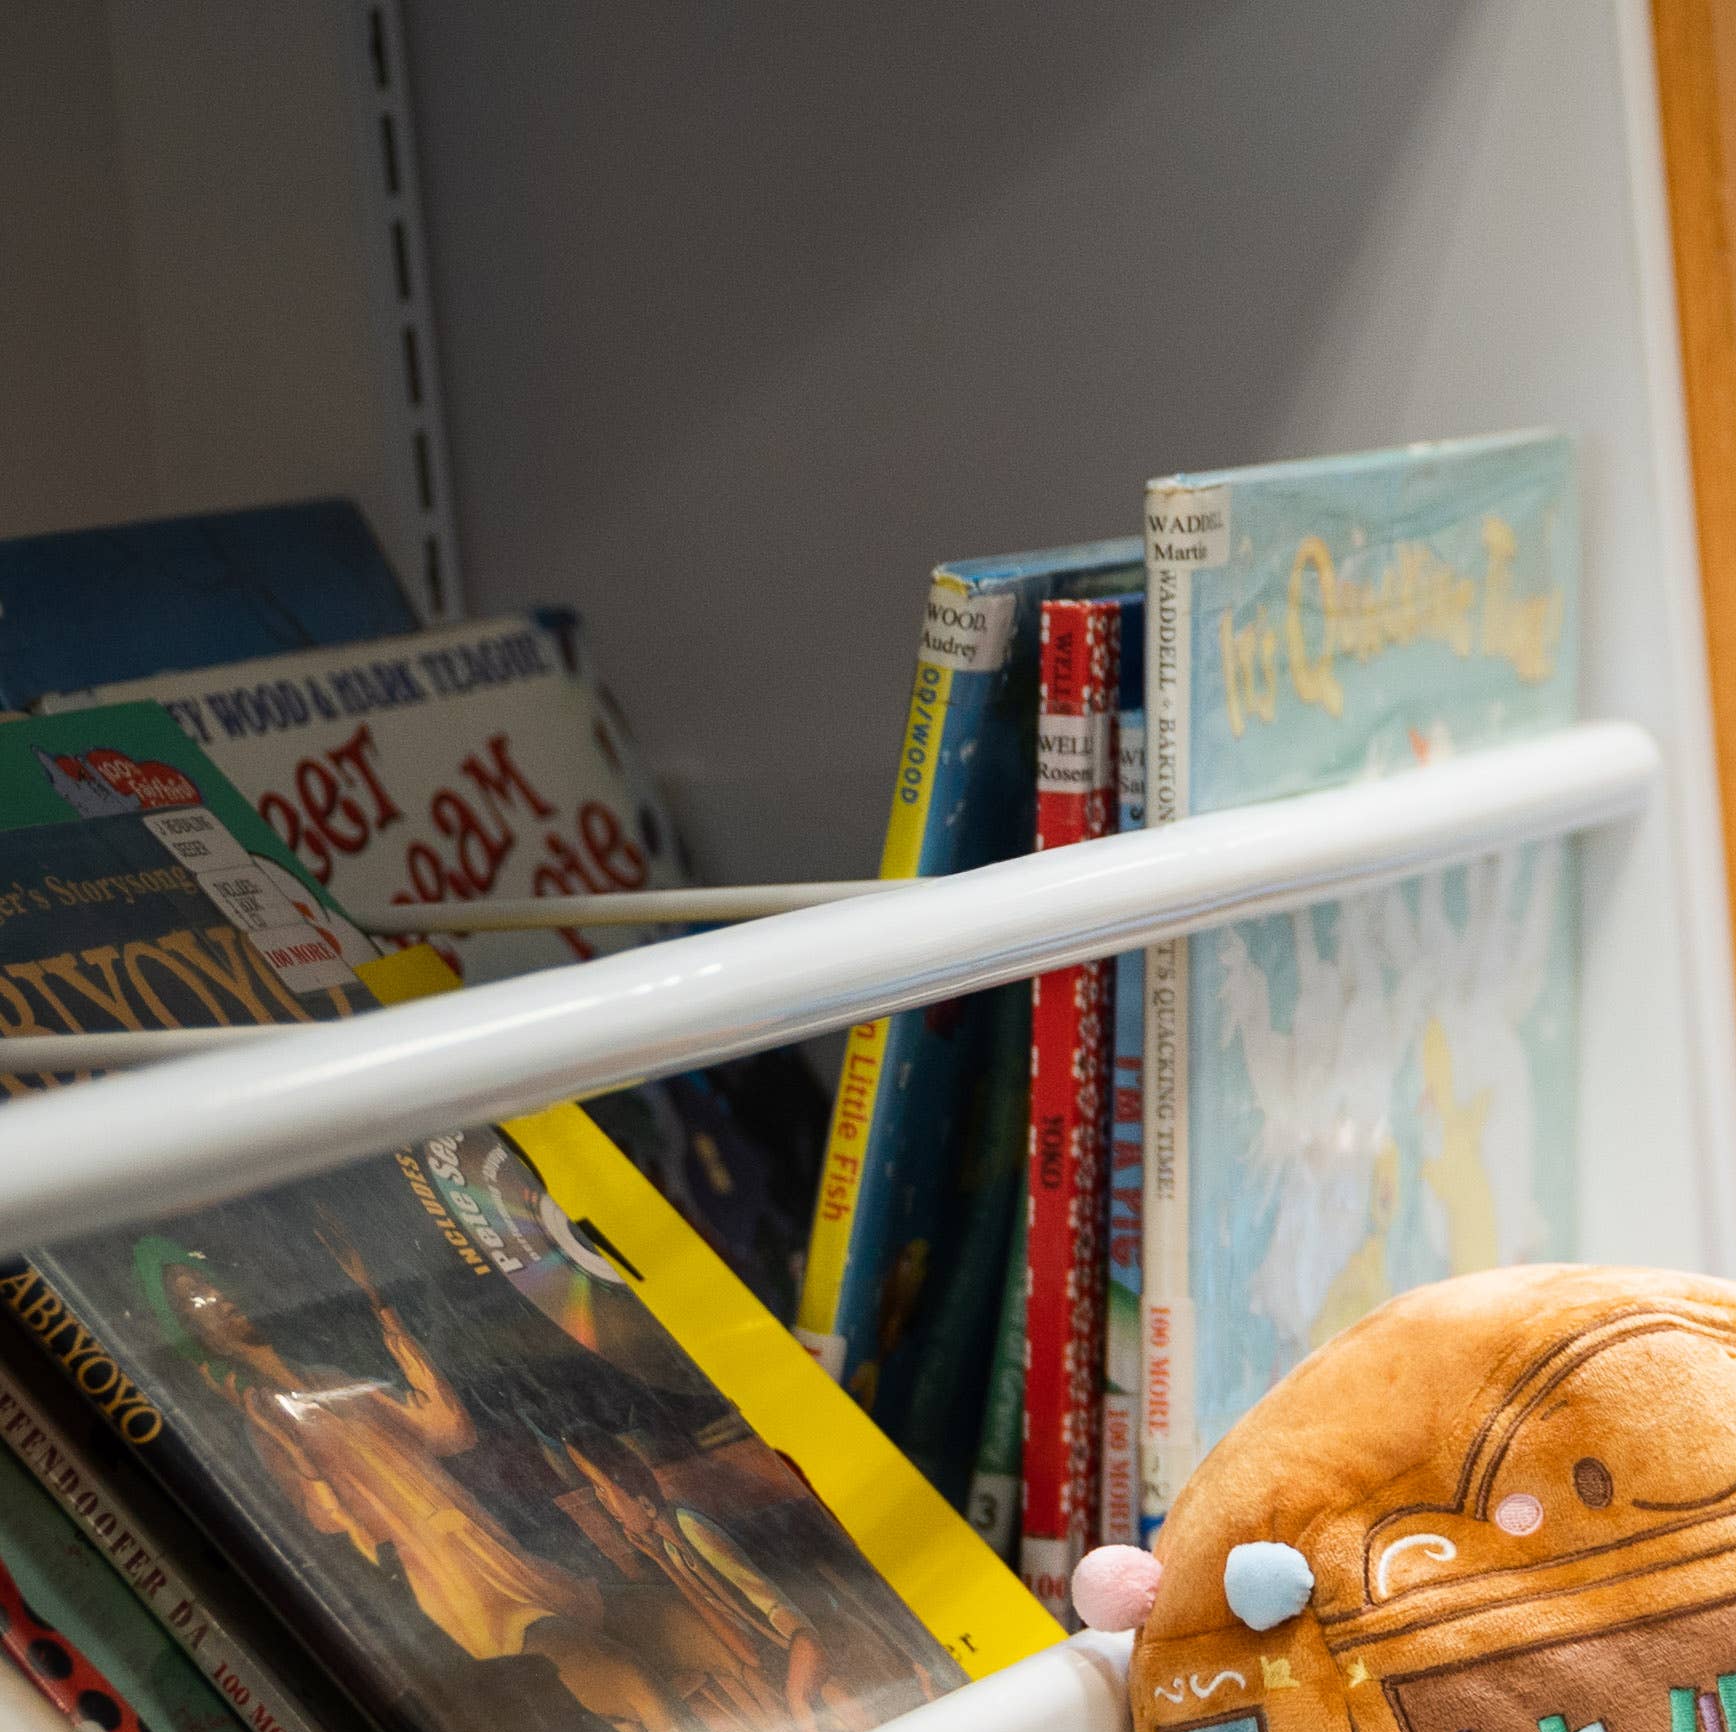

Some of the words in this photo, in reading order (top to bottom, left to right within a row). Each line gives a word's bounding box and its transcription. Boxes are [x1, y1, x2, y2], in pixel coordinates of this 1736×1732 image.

[1159, 570, 1177, 690] WADDELL
[1158, 719, 1176, 822] BARTON
[1153, 988, 1176, 1120] QUACKING
[837, 1054, 877, 1140] Little
[823, 1153, 859, 1221] Fish
[1040, 1115, 1065, 1190] YOKO
[396, 1150, 492, 1276] INCLUDES
[450, 1190, 524, 1274] Pete
[0, 1266, 163, 1445] ABIYOYO
[1149, 1307, 1171, 1348] 100
[1107, 1410, 1130, 1451] 100
[1148, 1358, 1171, 1437] MORE
[1109, 1460, 1130, 1535] MORE
[211, 1660, 252, 1707] 100
